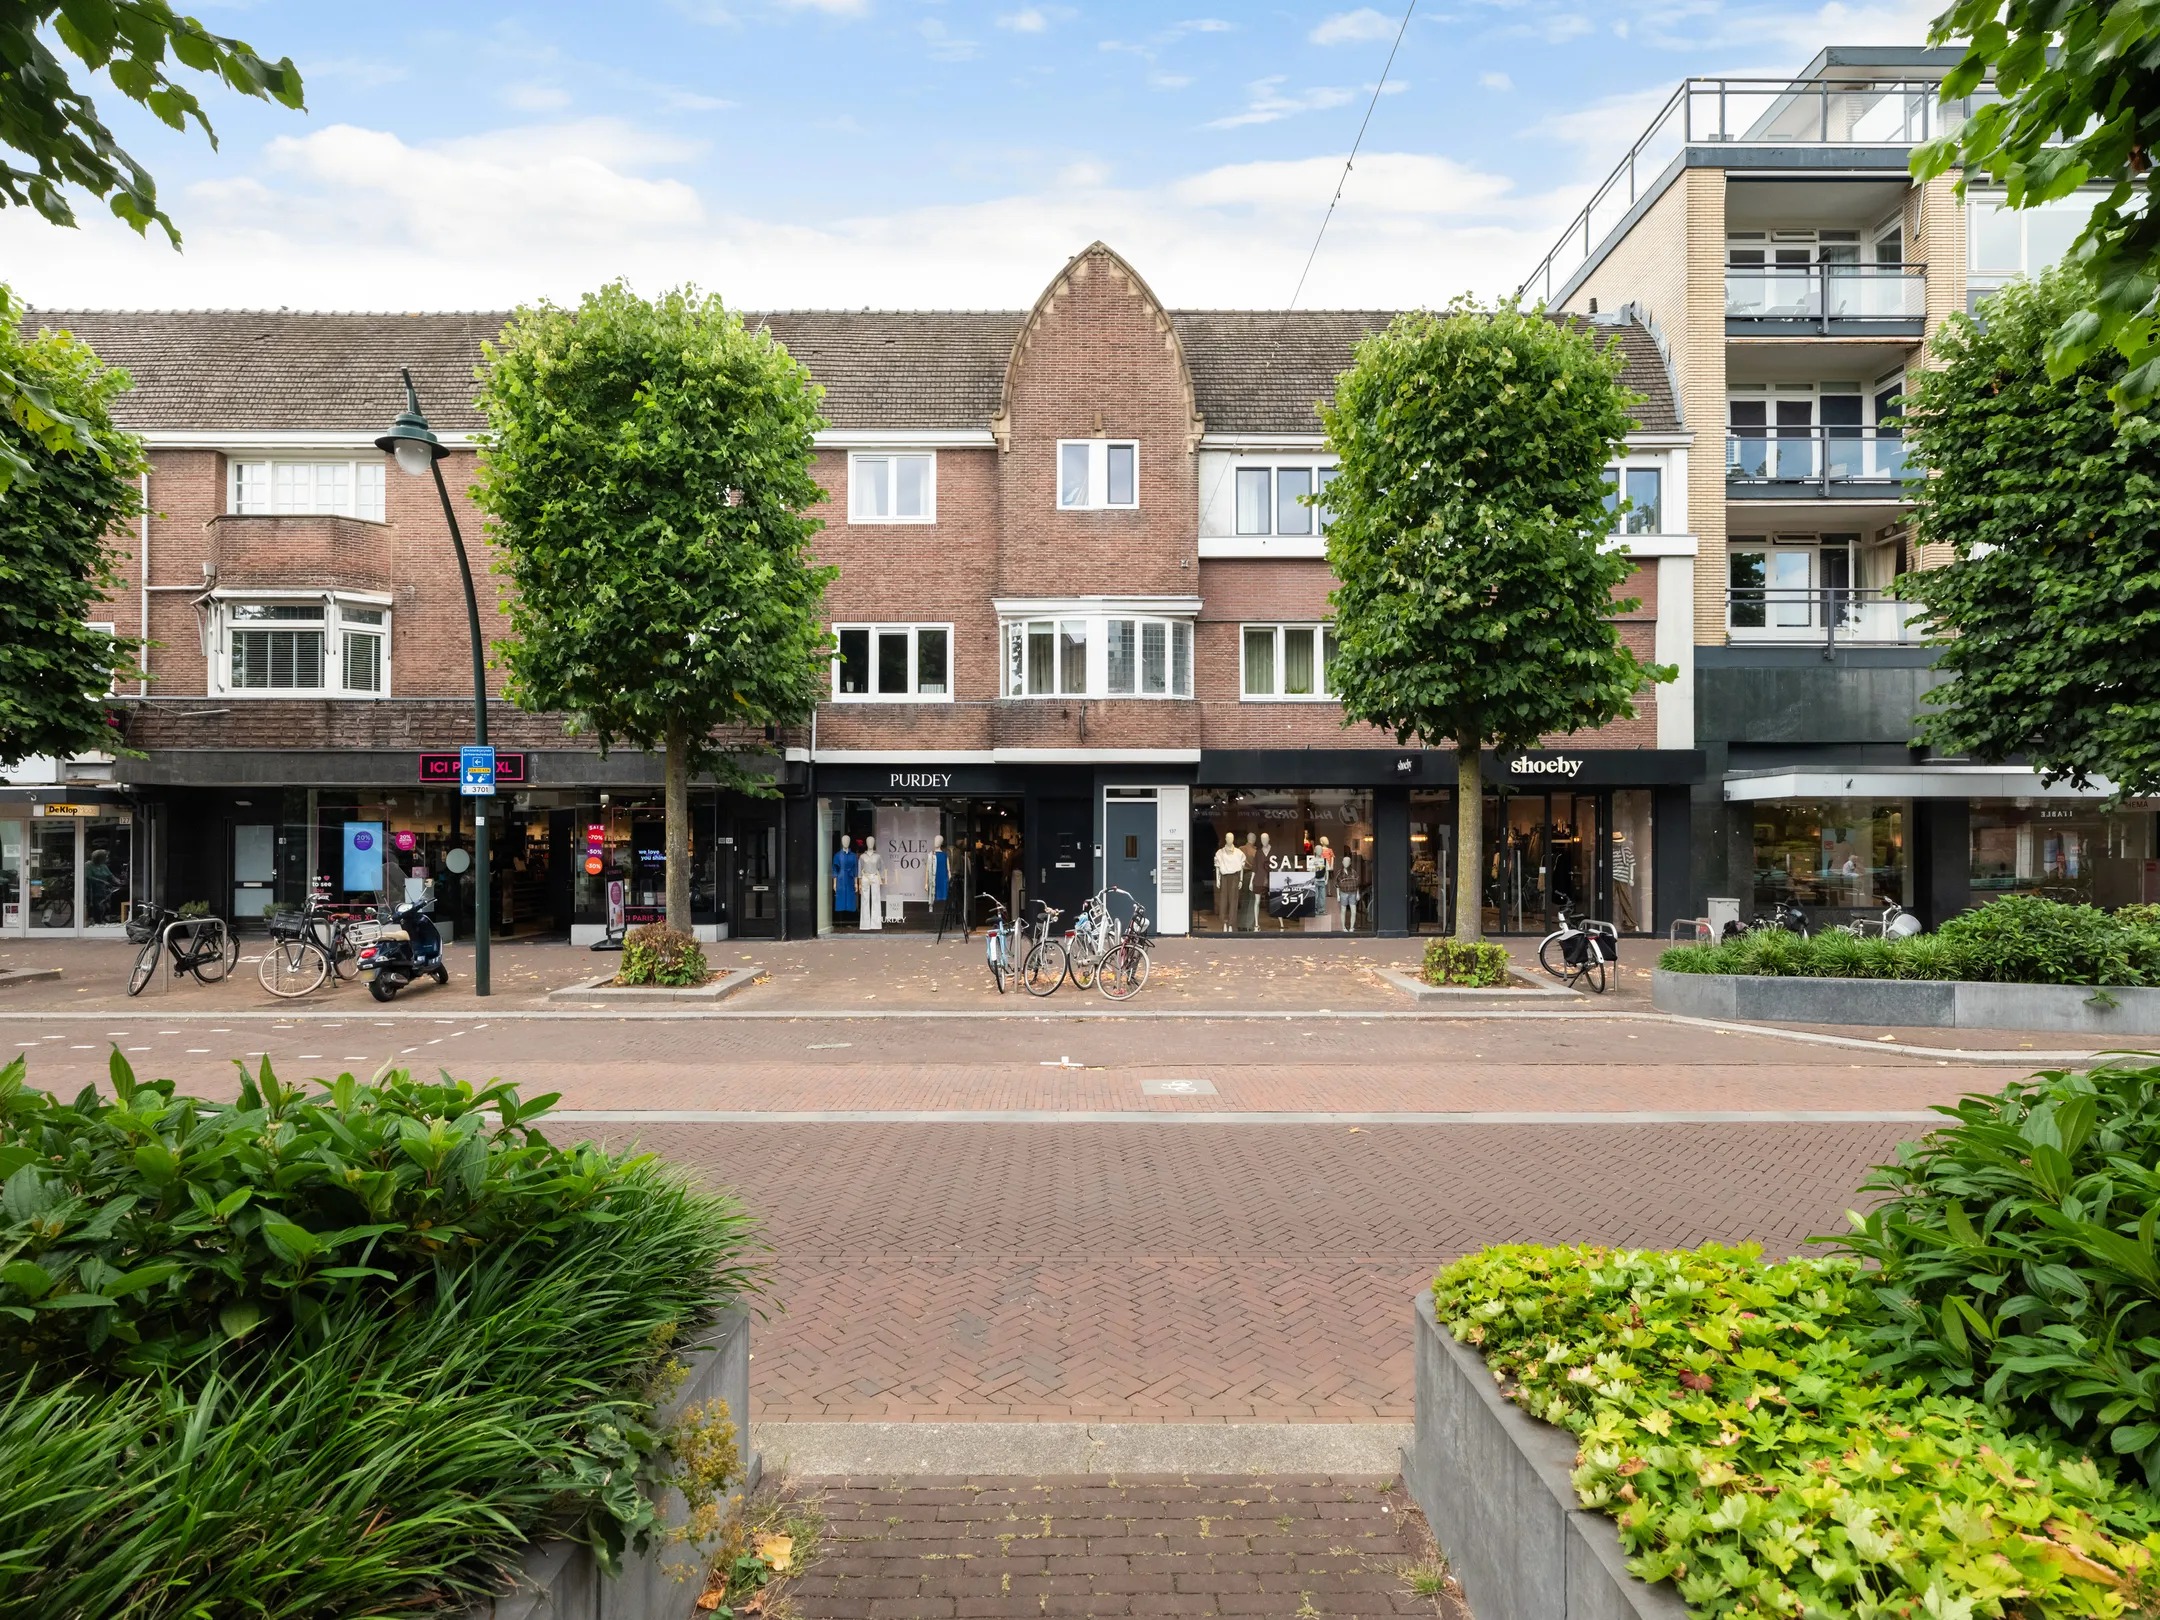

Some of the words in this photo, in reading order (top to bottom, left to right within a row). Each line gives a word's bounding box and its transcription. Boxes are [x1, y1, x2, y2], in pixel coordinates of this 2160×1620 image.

[430, 762, 448, 773] ICI
[496, 762, 512, 772] XL
[1510, 755, 1583, 777] shoeby
[890, 773, 952, 787] PURDEY
[888, 839, 928, 853] SALE
[1269, 856, 1316, 869] SALE
[1281, 893, 1304, 906] 3=1
